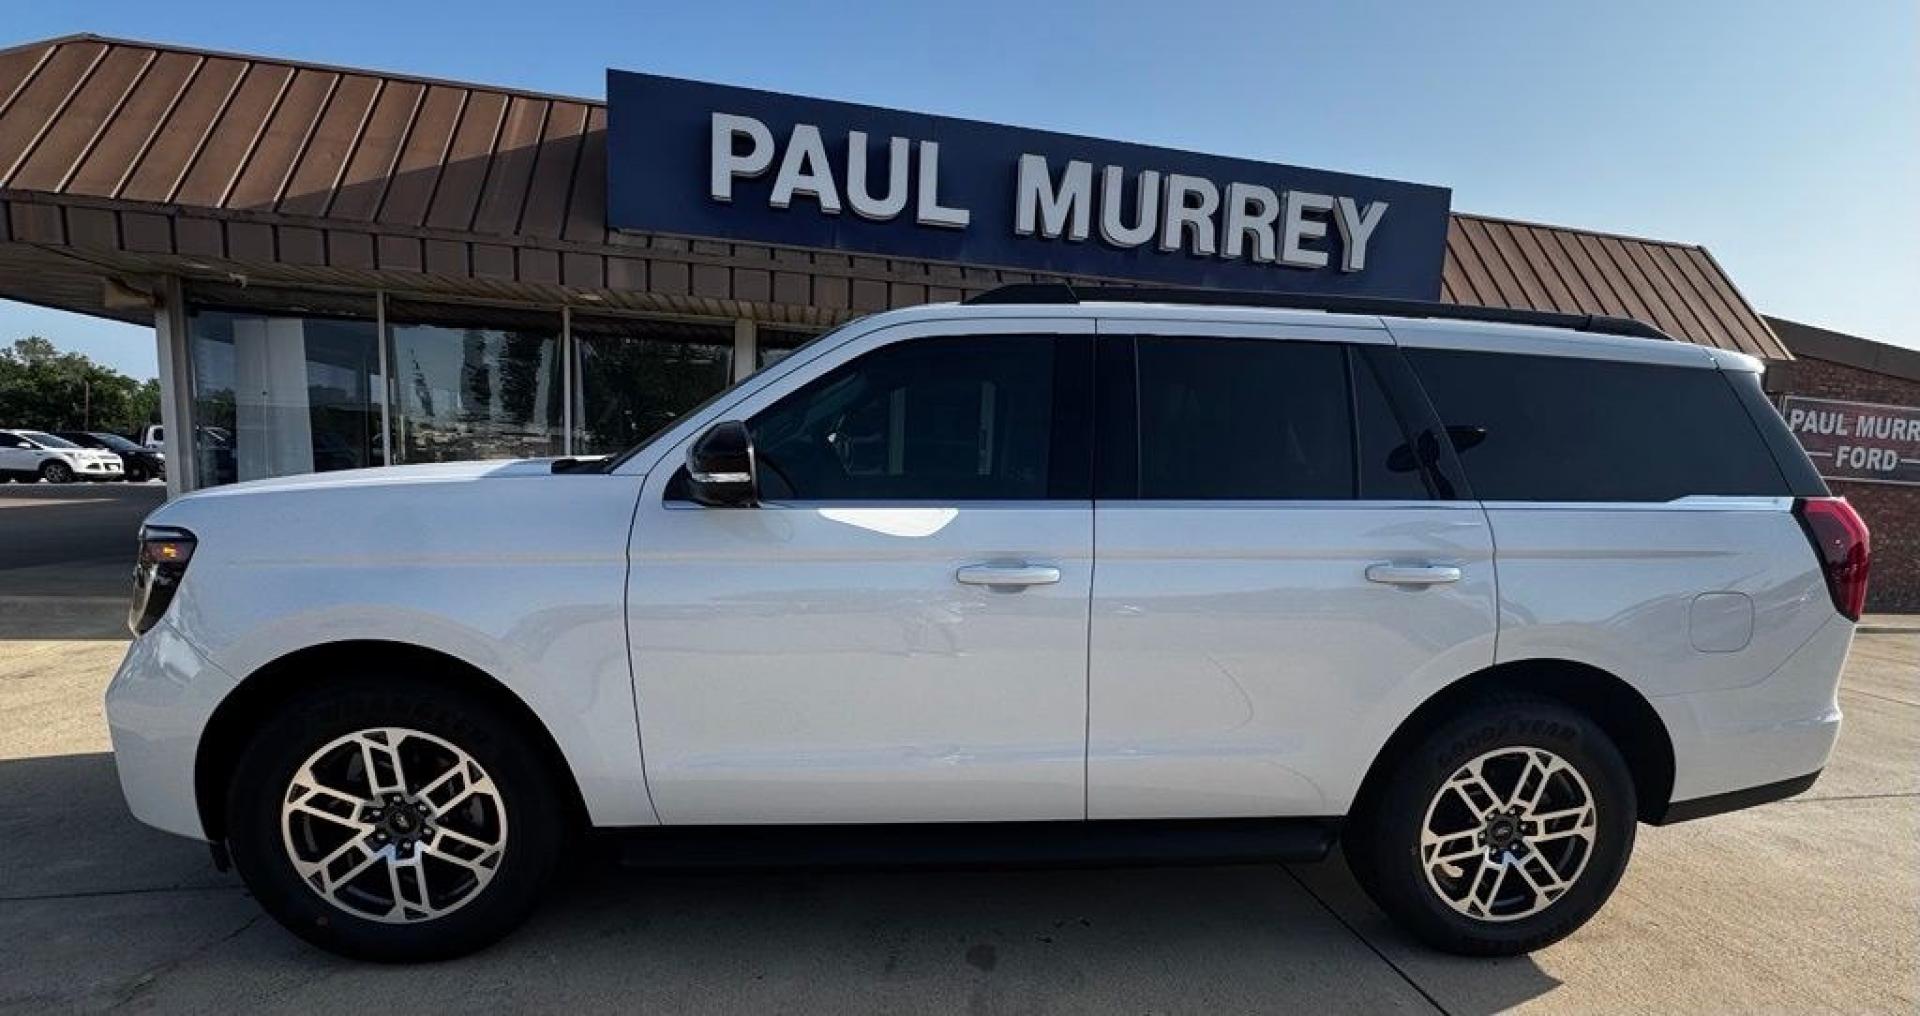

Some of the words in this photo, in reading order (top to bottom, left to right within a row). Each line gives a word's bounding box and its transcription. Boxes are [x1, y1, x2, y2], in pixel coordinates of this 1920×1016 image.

[711, 111, 970, 229] PAUL
[1015, 153, 1389, 273] MURREY
[1789, 408, 1848, 436] PAUL
[1835, 445, 1899, 471] FORD
